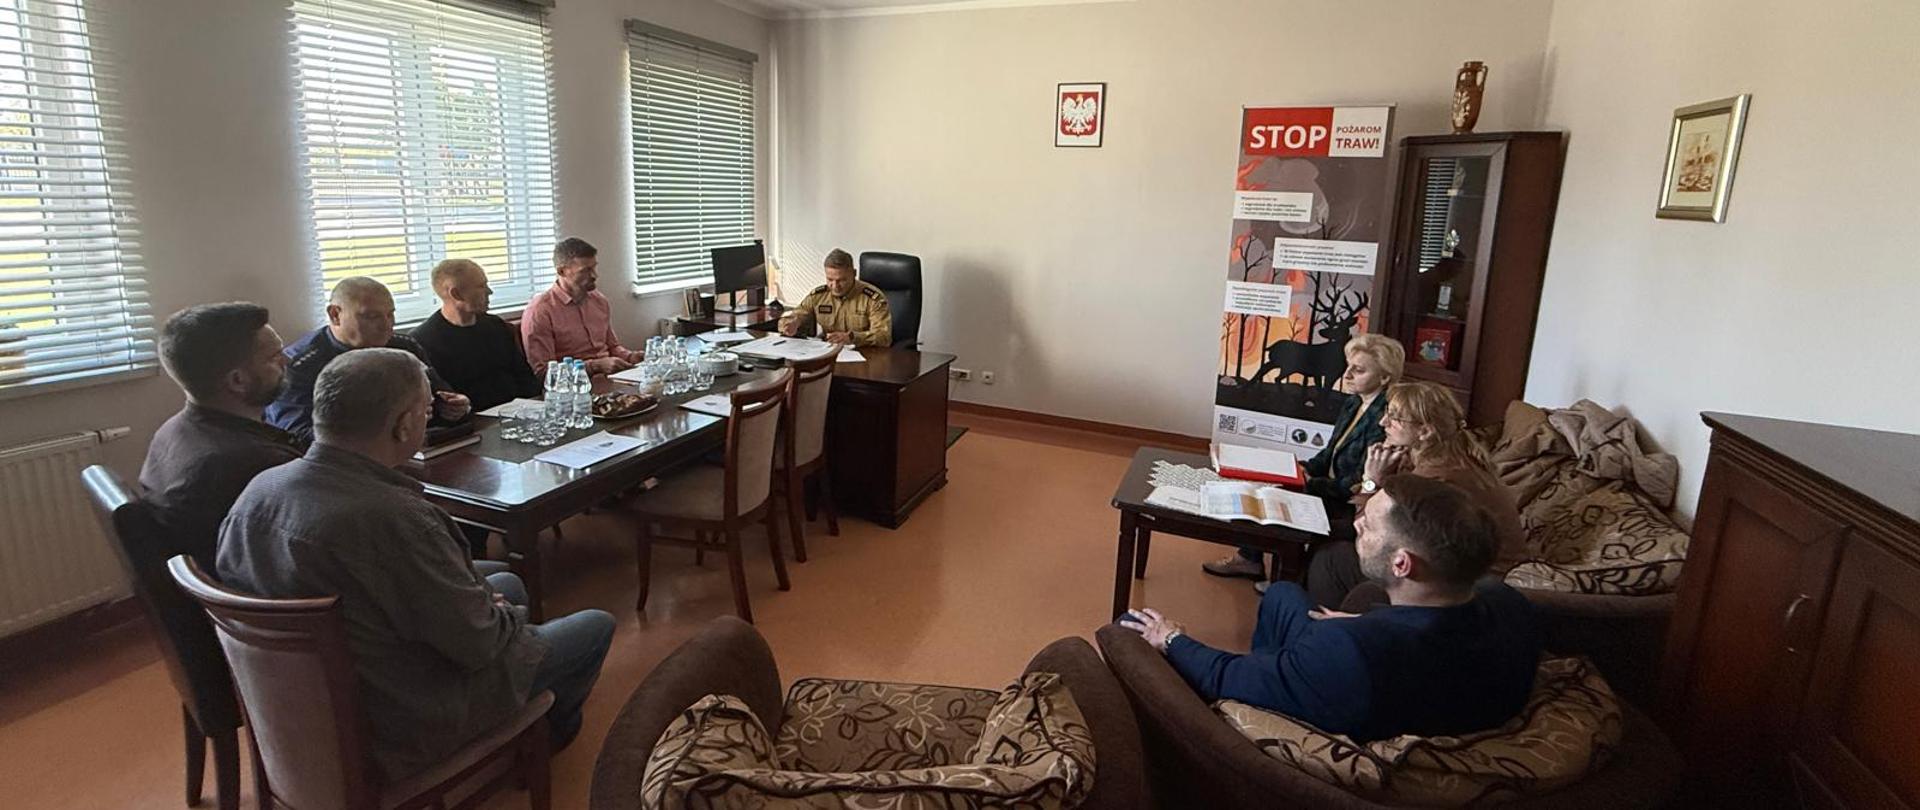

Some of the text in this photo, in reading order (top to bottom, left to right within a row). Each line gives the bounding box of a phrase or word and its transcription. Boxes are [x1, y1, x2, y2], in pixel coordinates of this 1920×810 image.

[1336, 125, 1382, 134] POŻAROM
[1250, 125, 1327, 149] STOP
[1336, 138, 1380, 149] TRAW!
